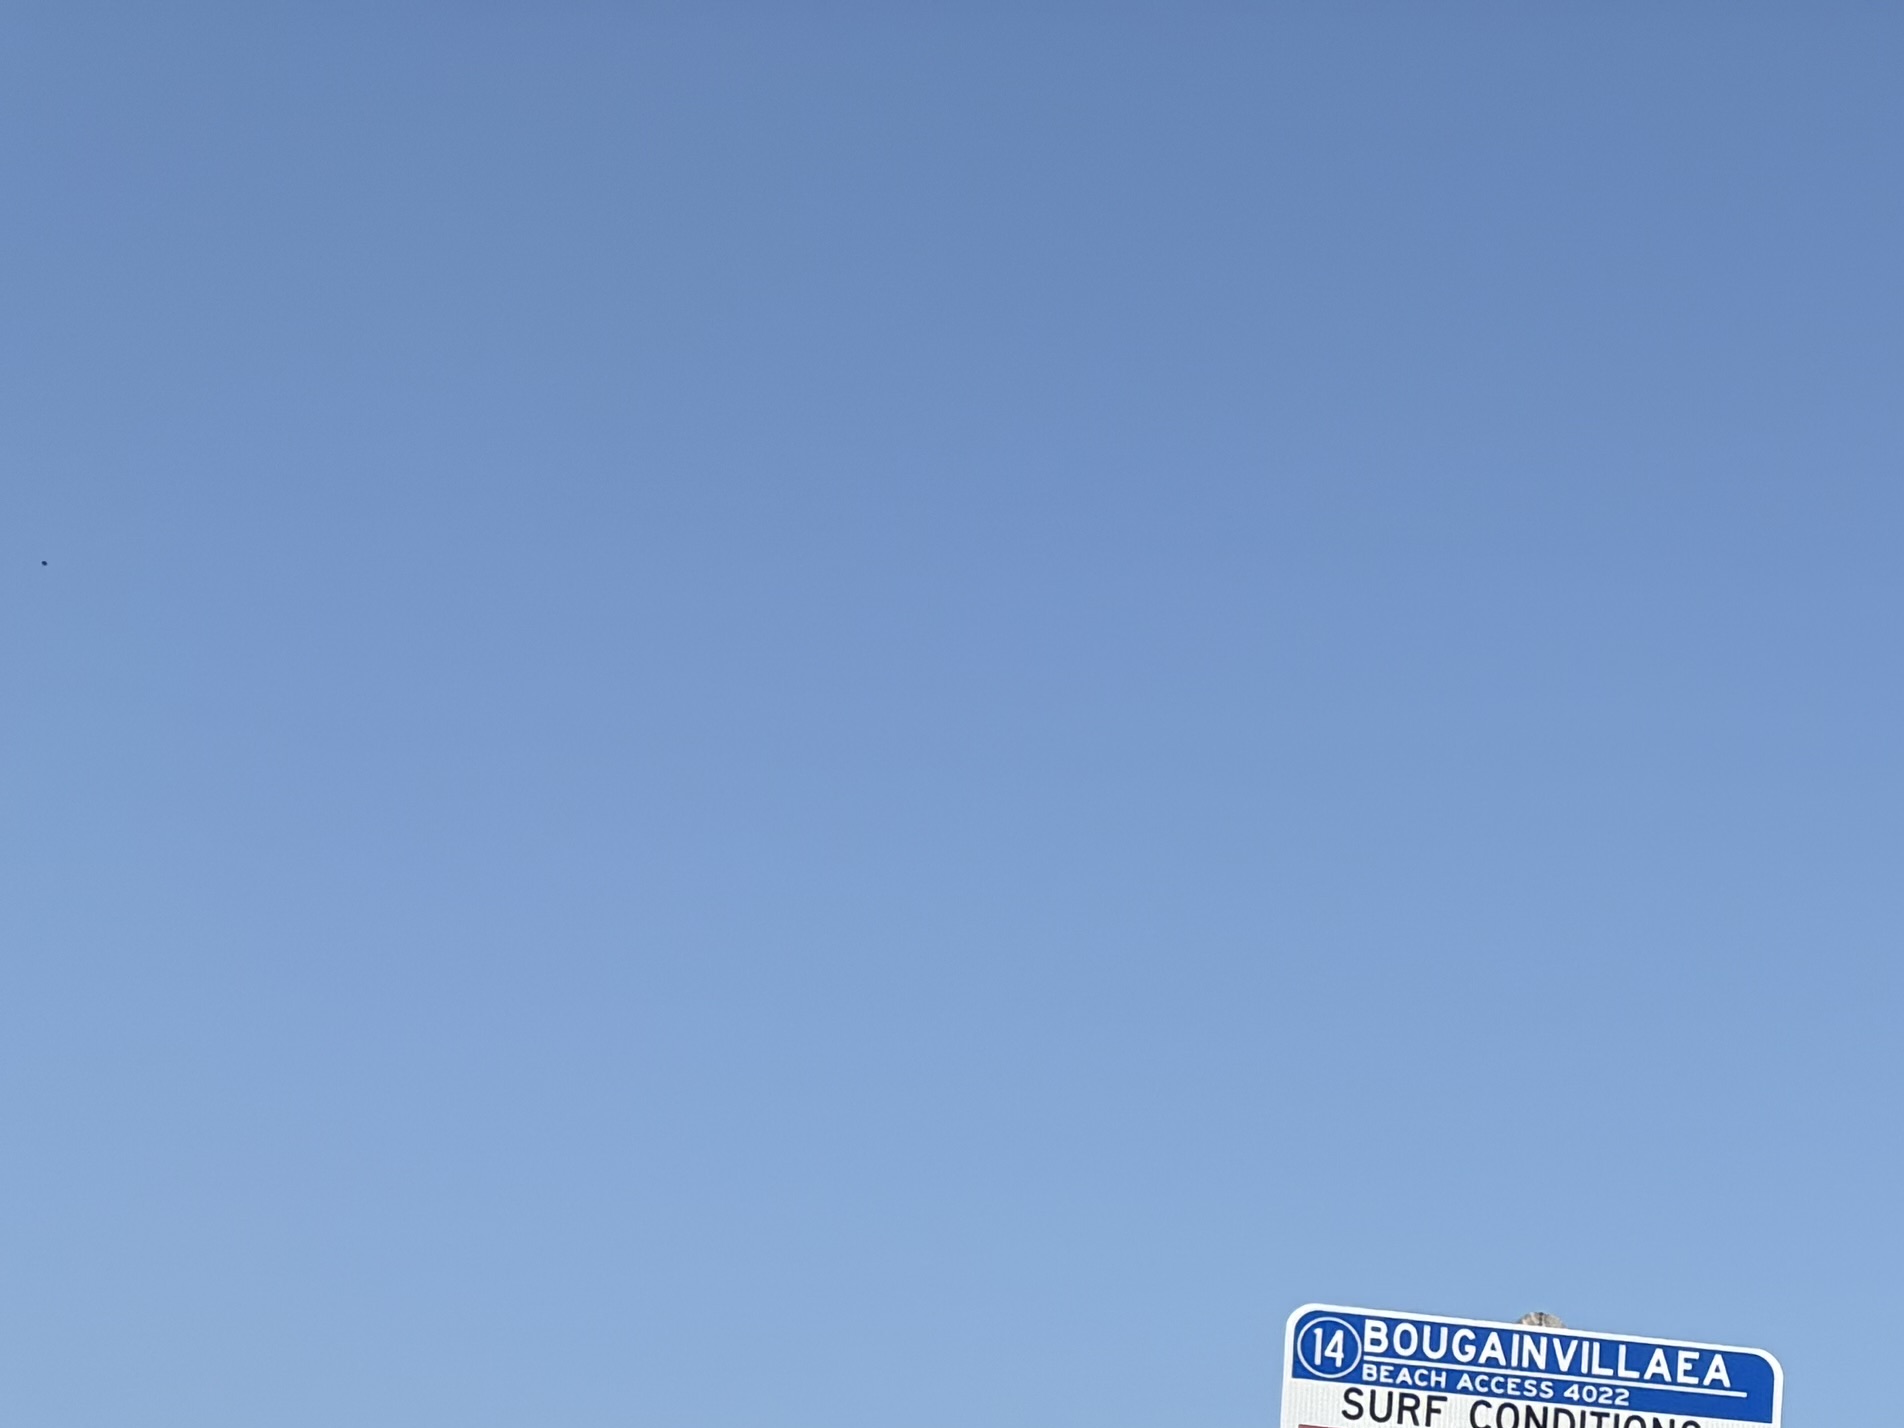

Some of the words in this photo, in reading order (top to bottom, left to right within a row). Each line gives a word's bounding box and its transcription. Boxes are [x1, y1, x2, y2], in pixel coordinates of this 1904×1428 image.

[1313, 1327, 1344, 1368] 14
[1363, 1318, 1731, 1388] BOUGAINVILLAEA
[1361, 1363, 1447, 1389] BEACH
[1456, 1373, 1554, 1398] ACCESS
[1563, 1384, 1630, 1406] 4022
[1341, 1387, 1448, 1427] SURF
